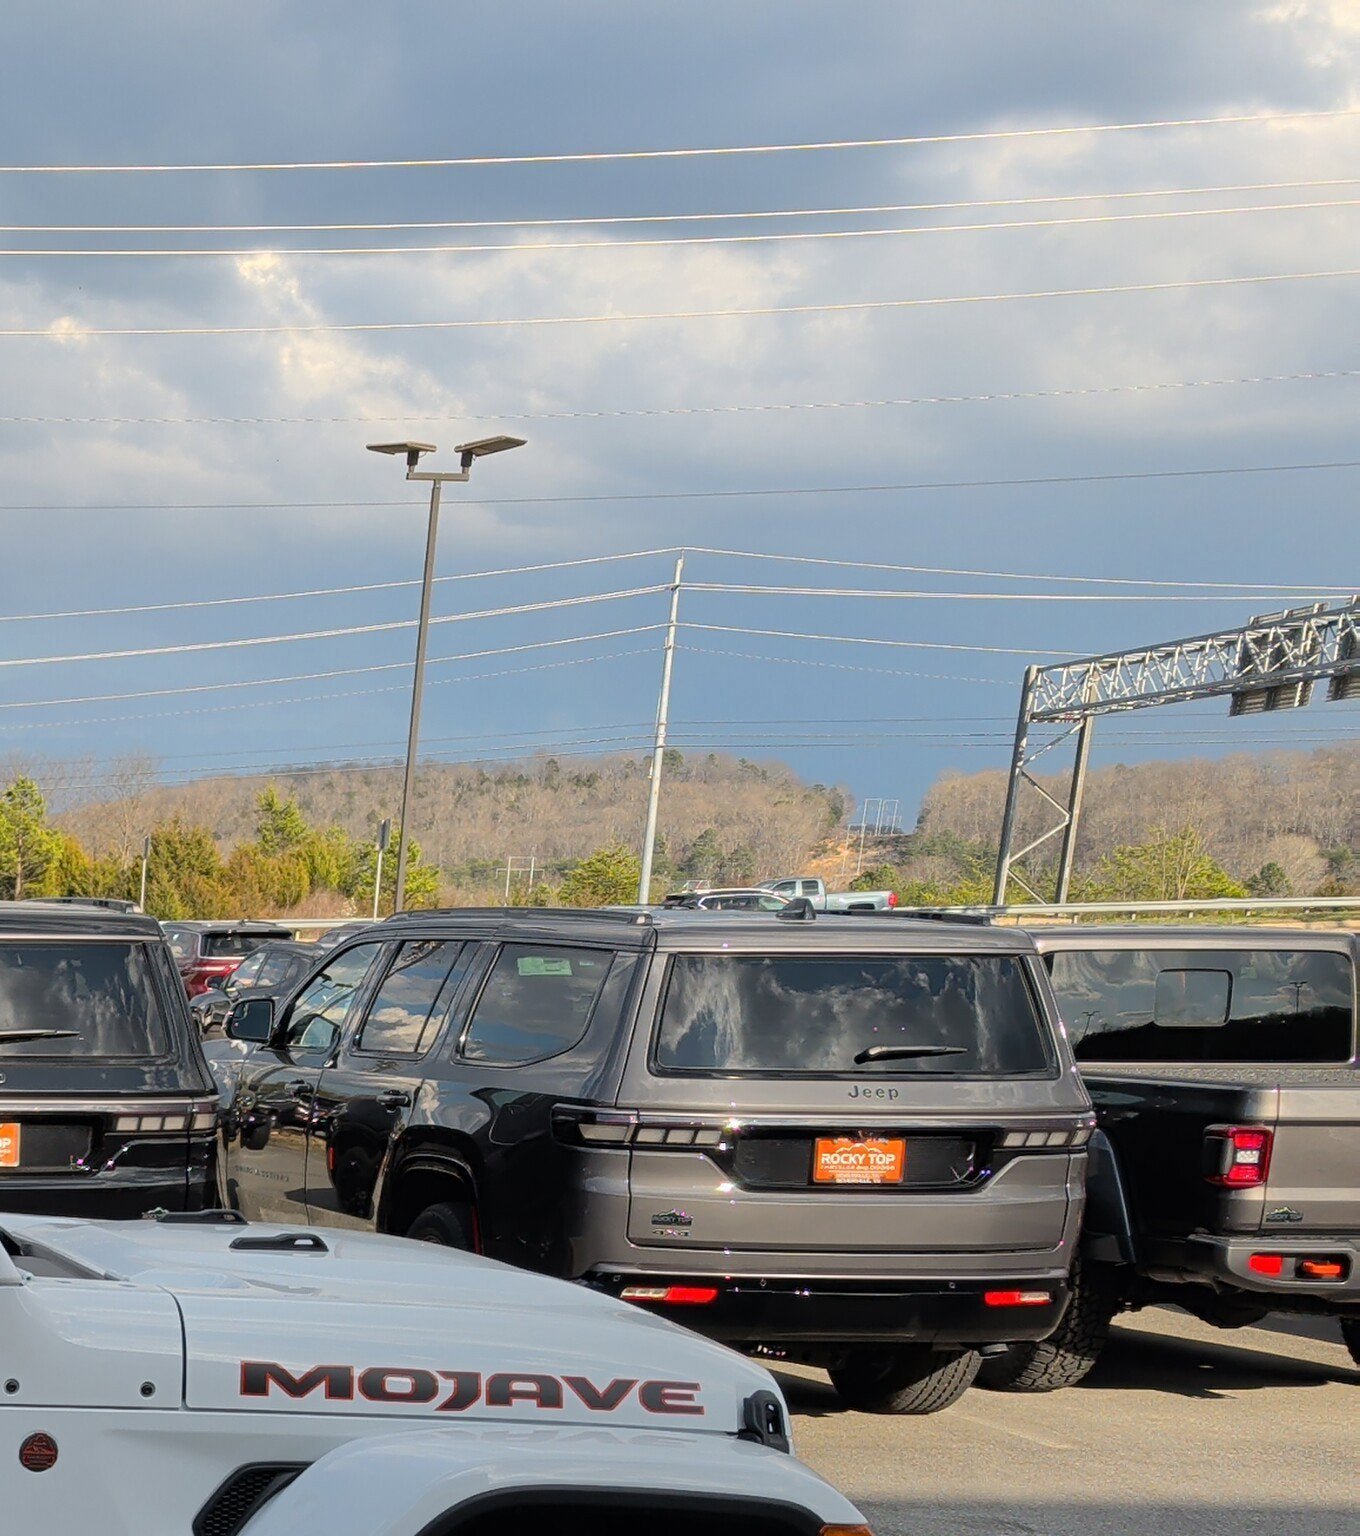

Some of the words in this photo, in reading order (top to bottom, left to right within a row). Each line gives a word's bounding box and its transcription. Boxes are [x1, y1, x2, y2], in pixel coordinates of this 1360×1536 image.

[848, 1084, 899, 1100] Jeep
[821, 1153, 867, 1165] ROCKY
[868, 1153, 896, 1165] TOP
[239, 1360, 705, 1415] MOJAVE
